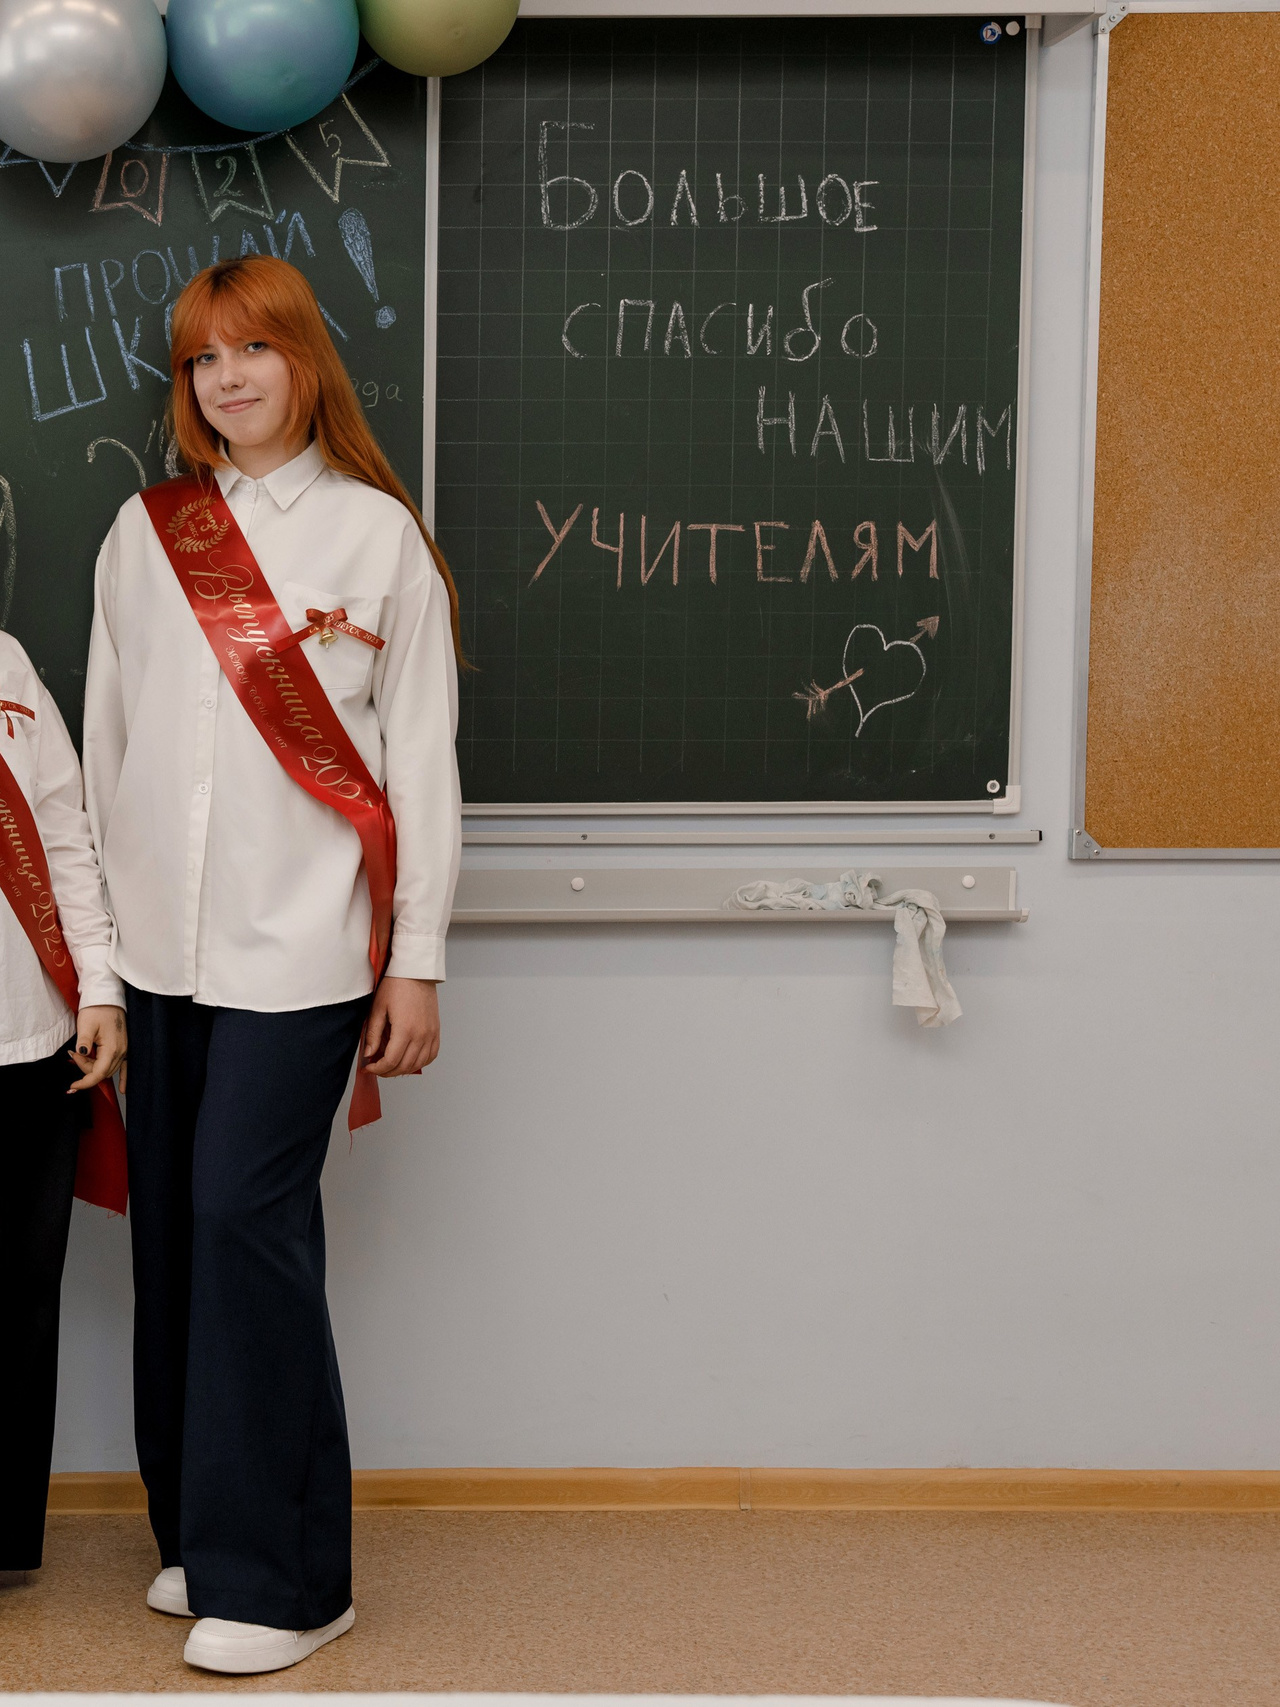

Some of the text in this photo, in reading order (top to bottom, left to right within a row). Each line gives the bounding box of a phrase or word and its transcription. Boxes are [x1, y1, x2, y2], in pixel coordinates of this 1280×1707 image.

[119, 99, 343, 198] 025
[756, 385, 1015, 476] НАШИМ
[528, 500, 940, 589] УЧИТЕЛЯМ
[188, 550, 323, 745] Выпускница
